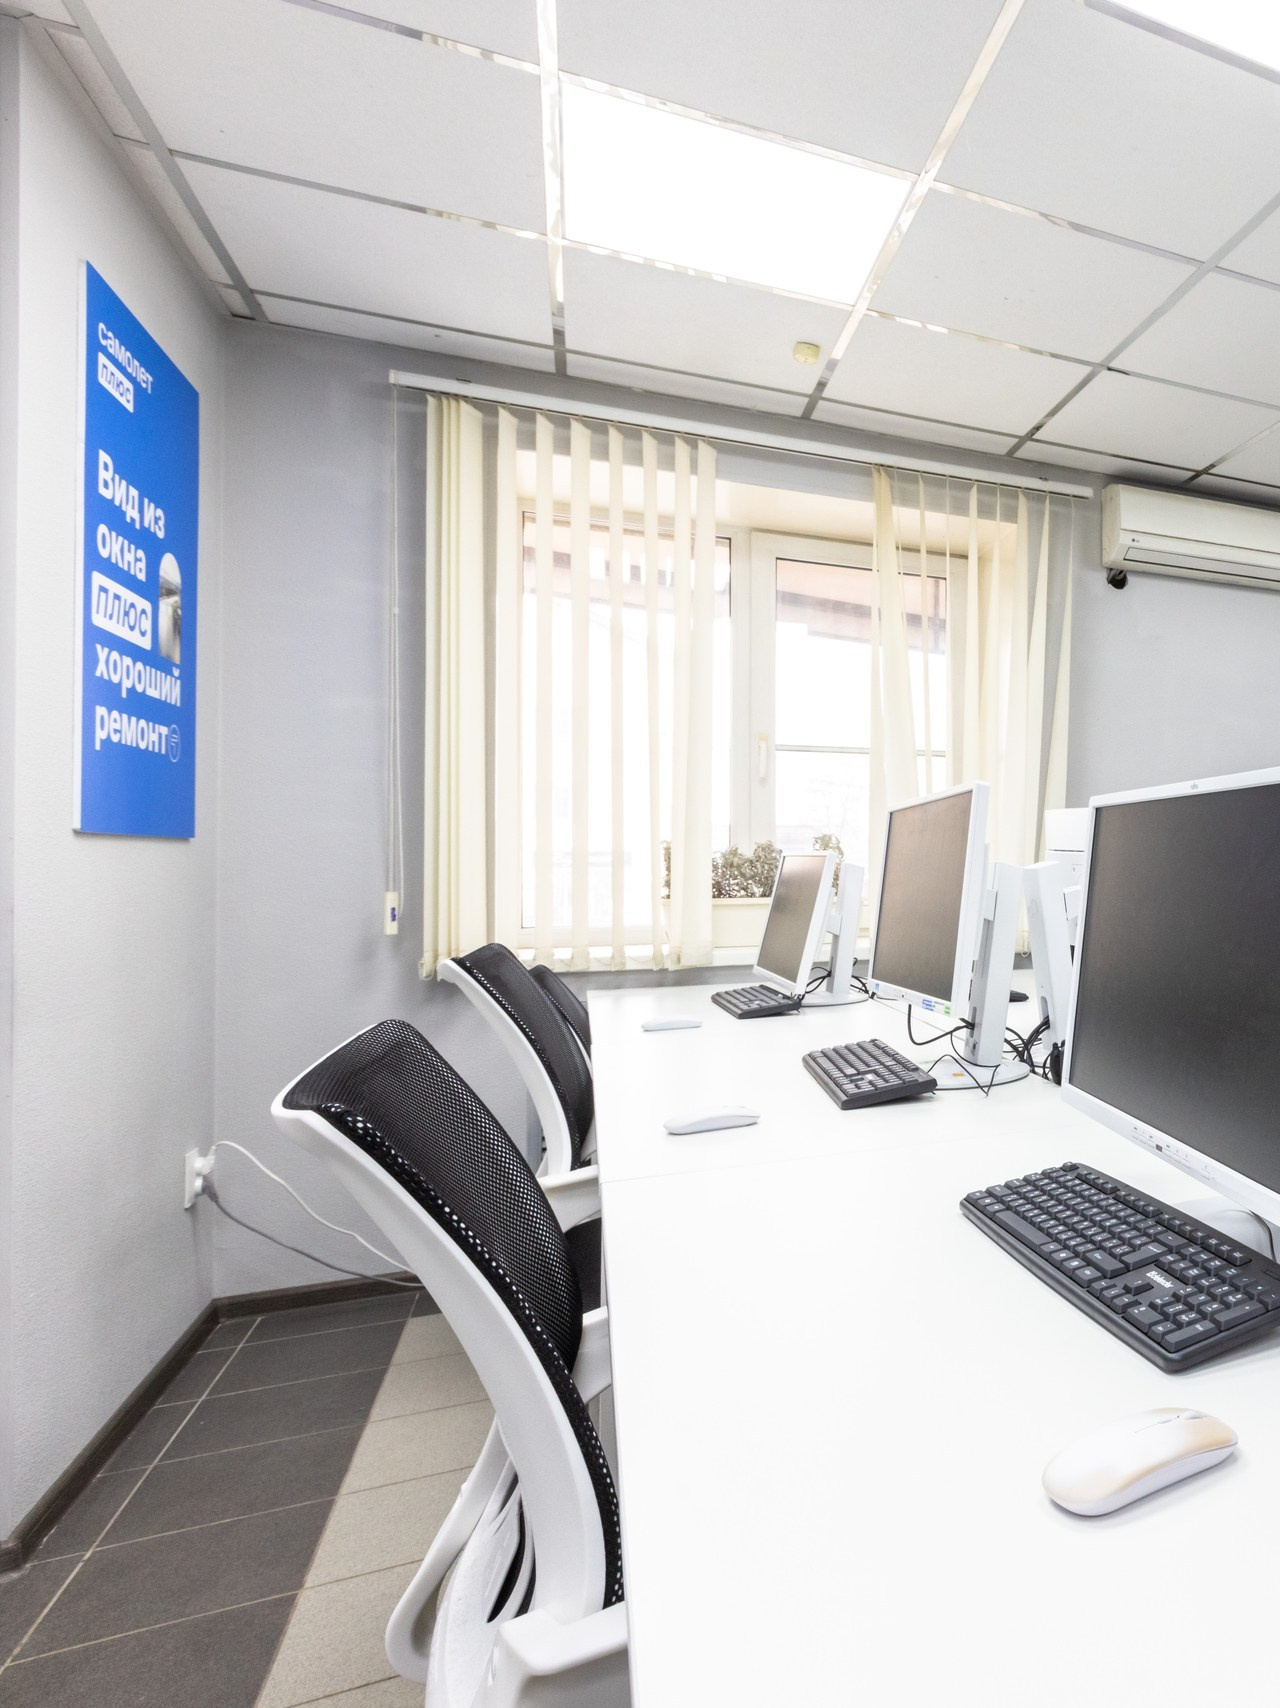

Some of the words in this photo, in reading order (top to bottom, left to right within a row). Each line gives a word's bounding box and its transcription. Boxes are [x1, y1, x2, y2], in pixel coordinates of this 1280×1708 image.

[98, 321, 153, 394] самолет
[101, 362, 131, 404] плюс
[98, 448, 140, 530] Вид
[143, 497, 165, 539] из
[97, 523, 146, 582] окна
[97, 584, 148, 637] плюс
[95, 643, 181, 707] хороший
[95, 704, 168, 755] ремонт
